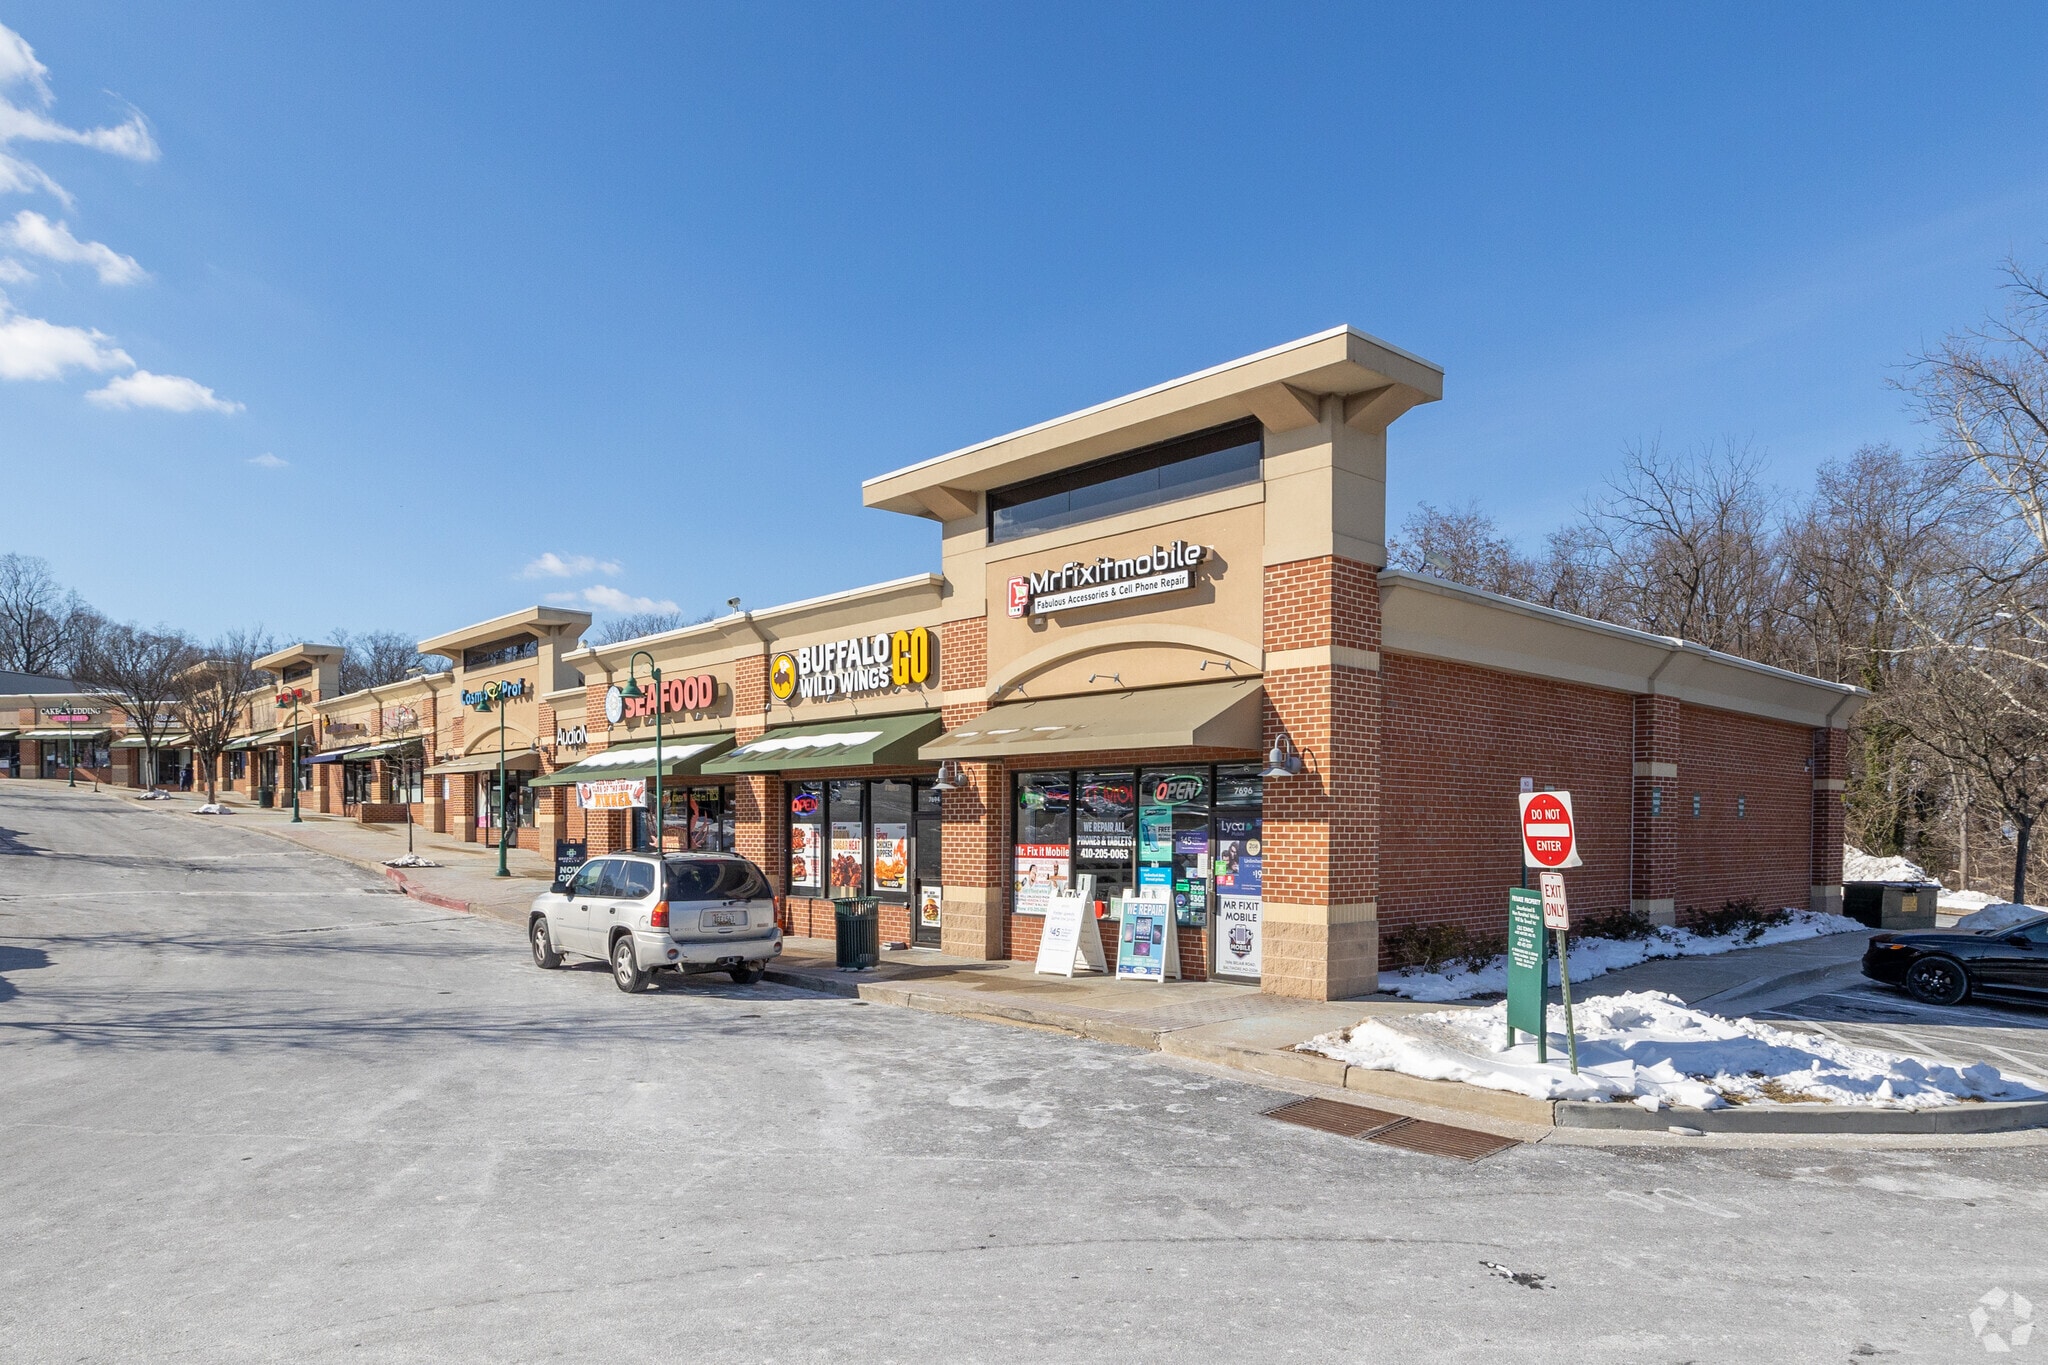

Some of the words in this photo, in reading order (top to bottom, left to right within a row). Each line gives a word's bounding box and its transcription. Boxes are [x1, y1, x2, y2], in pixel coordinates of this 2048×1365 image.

[1037, 597, 1066, 609] Fabulous
[1068, 589, 1109, 604] Accessories
[1111, 587, 1117, 596] &
[1119, 585, 1133, 595] Cell
[1135, 580, 1158, 592] Phone
[1160, 574, 1186, 588] Repair
[798, 633, 889, 675] BUFFALO
[891, 626, 928, 686] GO
[799, 675, 837, 698] WILD
[838, 666, 889, 693] WINGS
[502, 678, 523, 698] Prof
[624, 674, 713, 718] SEAFOOD
[66, 707, 102, 716] WEDDING
[1156, 781, 1197, 800] OPEN
[1234, 787, 1253, 795] 7696
[792, 798, 819, 812] OPEN
[1531, 809, 1542, 820] DO
[1545, 809, 1561, 820] NOT
[1083, 822, 1092, 832] WE
[1093, 822, 1114, 832] REPAIR
[1114, 822, 1126, 833] ALL
[1221, 820, 1245, 833] Lyca
[848, 840, 861, 851] HEAT
[876, 841, 893, 849] CHICKEN
[1077, 835, 1100, 846] PHONES
[1101, 836, 1106, 845] &
[1107, 836, 1132, 847] TABLETS
[1180, 836, 1192, 846] $45
[1536, 840, 1562, 852] ENTER
[876, 849, 893, 858] DIPPERS
[1027, 846, 1038, 857] Fix
[1039, 846, 1045, 856] it
[1046, 846, 1070, 857] Mobile
[1080, 848, 1129, 859] 410-205-0063
[1545, 884, 1561, 898] EXIT
[1127, 903, 1138, 915] WE
[1138, 903, 1165, 916] REPAIR!
[1223, 900, 1237, 910] MR
[1238, 902, 1259, 911] FIXIT
[1546, 902, 1565, 918] ONLY
[1225, 912, 1257, 922] MOBILE
[1231, 943, 1251, 951] MOBILE
